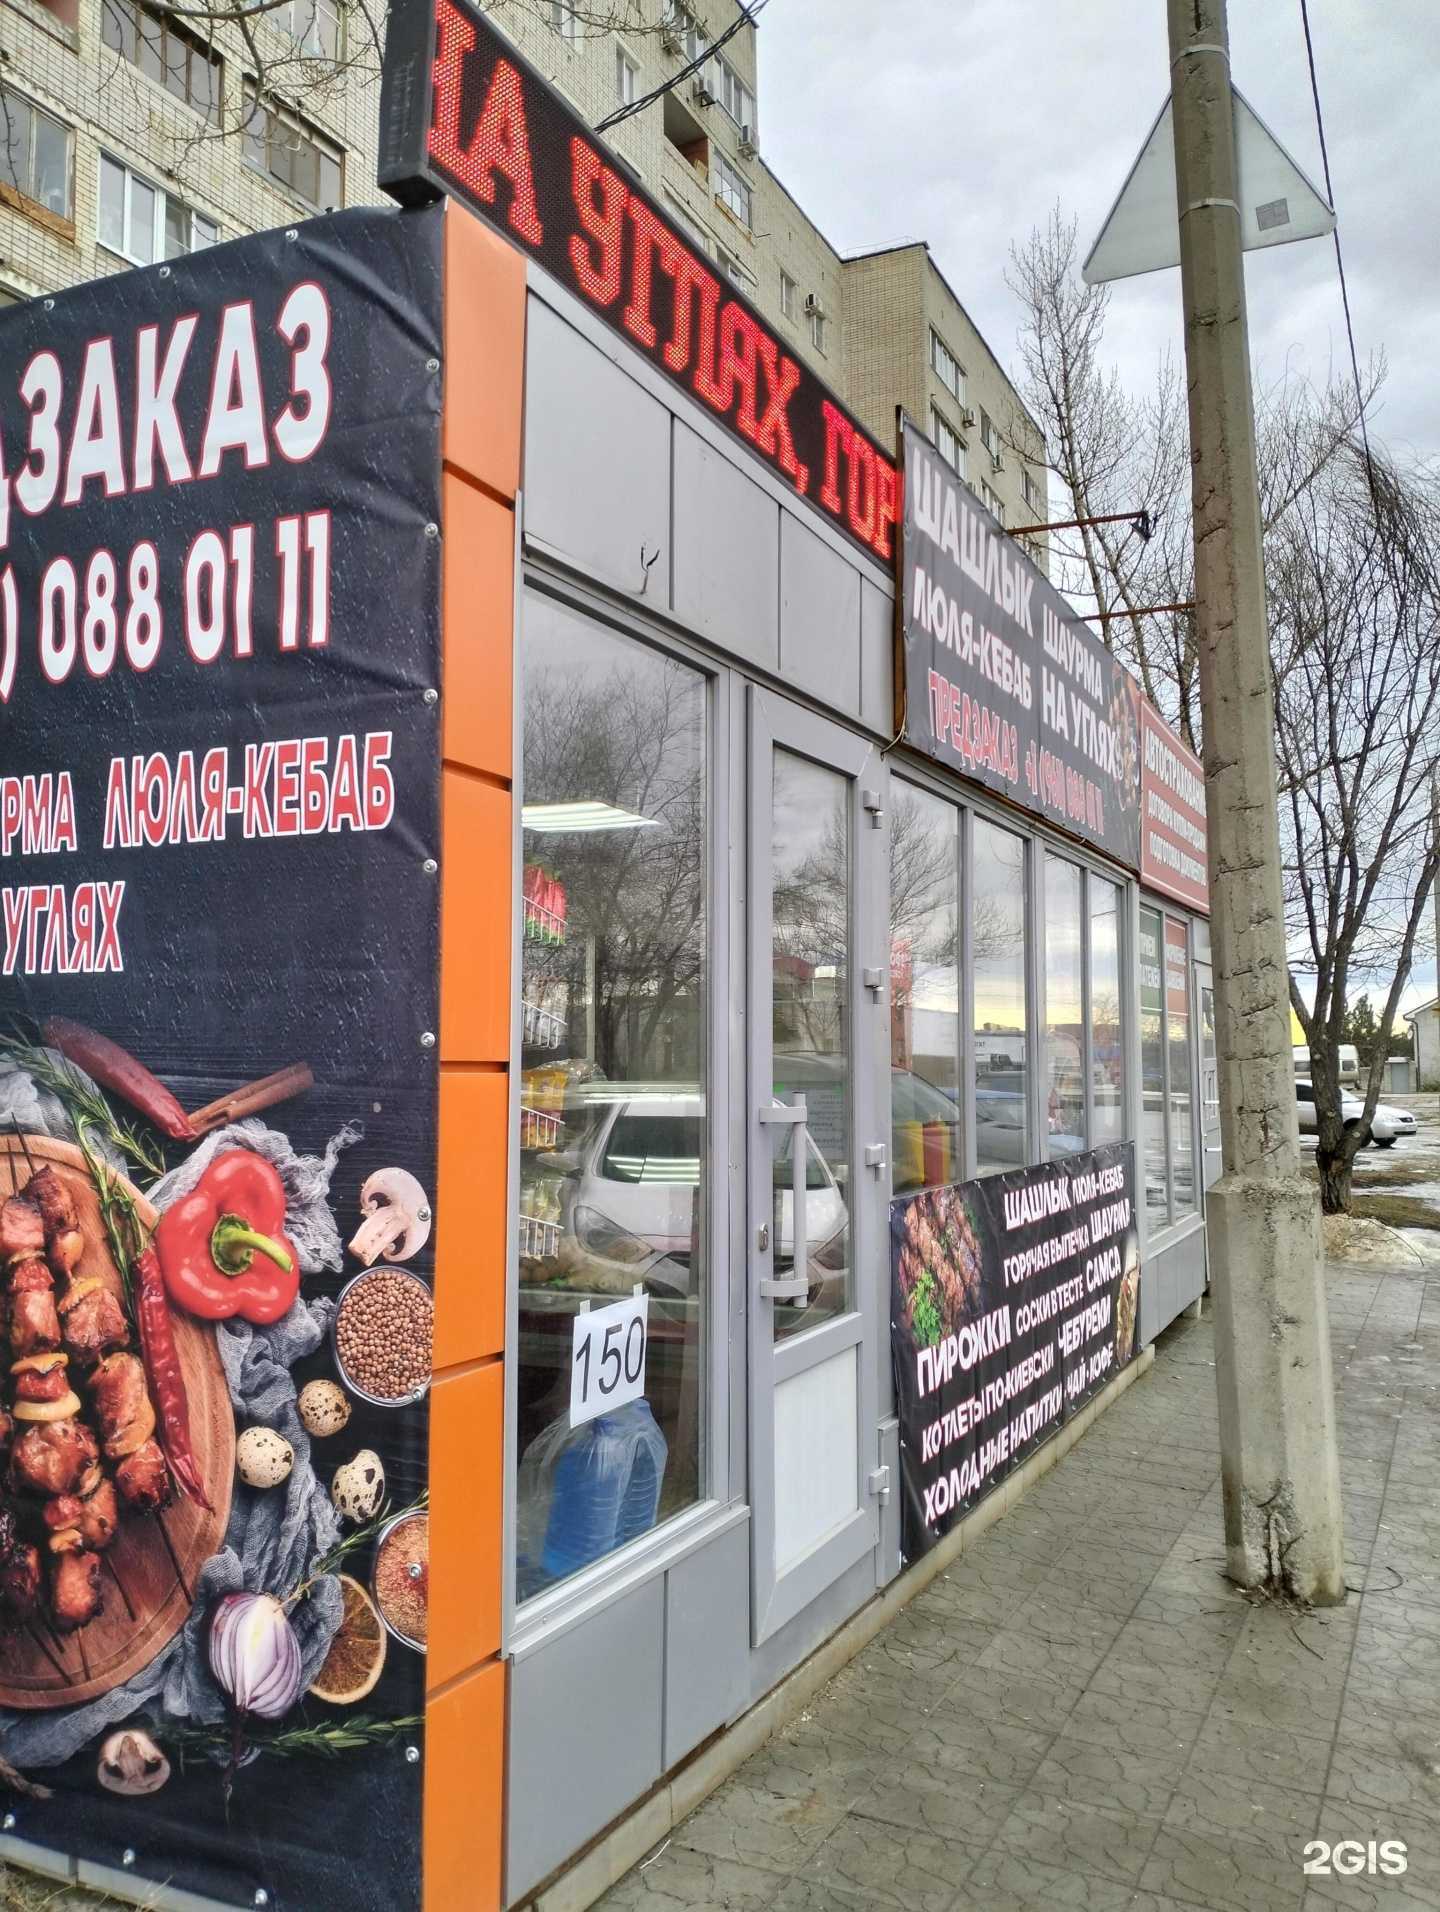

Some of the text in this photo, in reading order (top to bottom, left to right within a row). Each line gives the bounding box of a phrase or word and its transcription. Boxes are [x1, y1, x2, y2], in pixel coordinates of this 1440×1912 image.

[0, 280, 333, 550] ЗАКАЗ
[38, 538, 163, 686] 088
[184, 521, 255, 665] 01
[276, 508, 331, 654] 11
[913, 447, 1104, 706] ШАШЛЫК ШАУРМА
[912, 566, 1118, 782] ЛЮЛЯ-КЕБАБ НА УГЛЯХ
[928, 667, 1019, 785] ПРЕДЗАКАЗ
[0, 729, 395, 857] РМА ЛЮЛЯ-КЕБАБ
[2, 880, 126, 976] УГЛЯХ
[1003, 1242, 1050, 1288] ГОРЯЧАЯ
[1050, 1224, 1090, 1265] ВЫПЕЧКА
[1004, 1165, 1124, 1231] ШАШЛЫК ЛЮЛЯ-КЕБАБ
[576, 1316, 645, 1403] 150
[917, 1304, 1011, 1398] ПИРОЖКИ
[1086, 1245, 1121, 1293] САМСА
[922, 1396, 986, 1463] КОТЛЕТЫ
[1057, 1294, 1111, 1358] ЧЕБУРЕКИ
[923, 1426, 1009, 1527] ХОЛОДНЫЕ
[1009, 1383, 1063, 1454] НАПИТКИ
[1067, 1357, 1086, 1400] ЧАЙ
